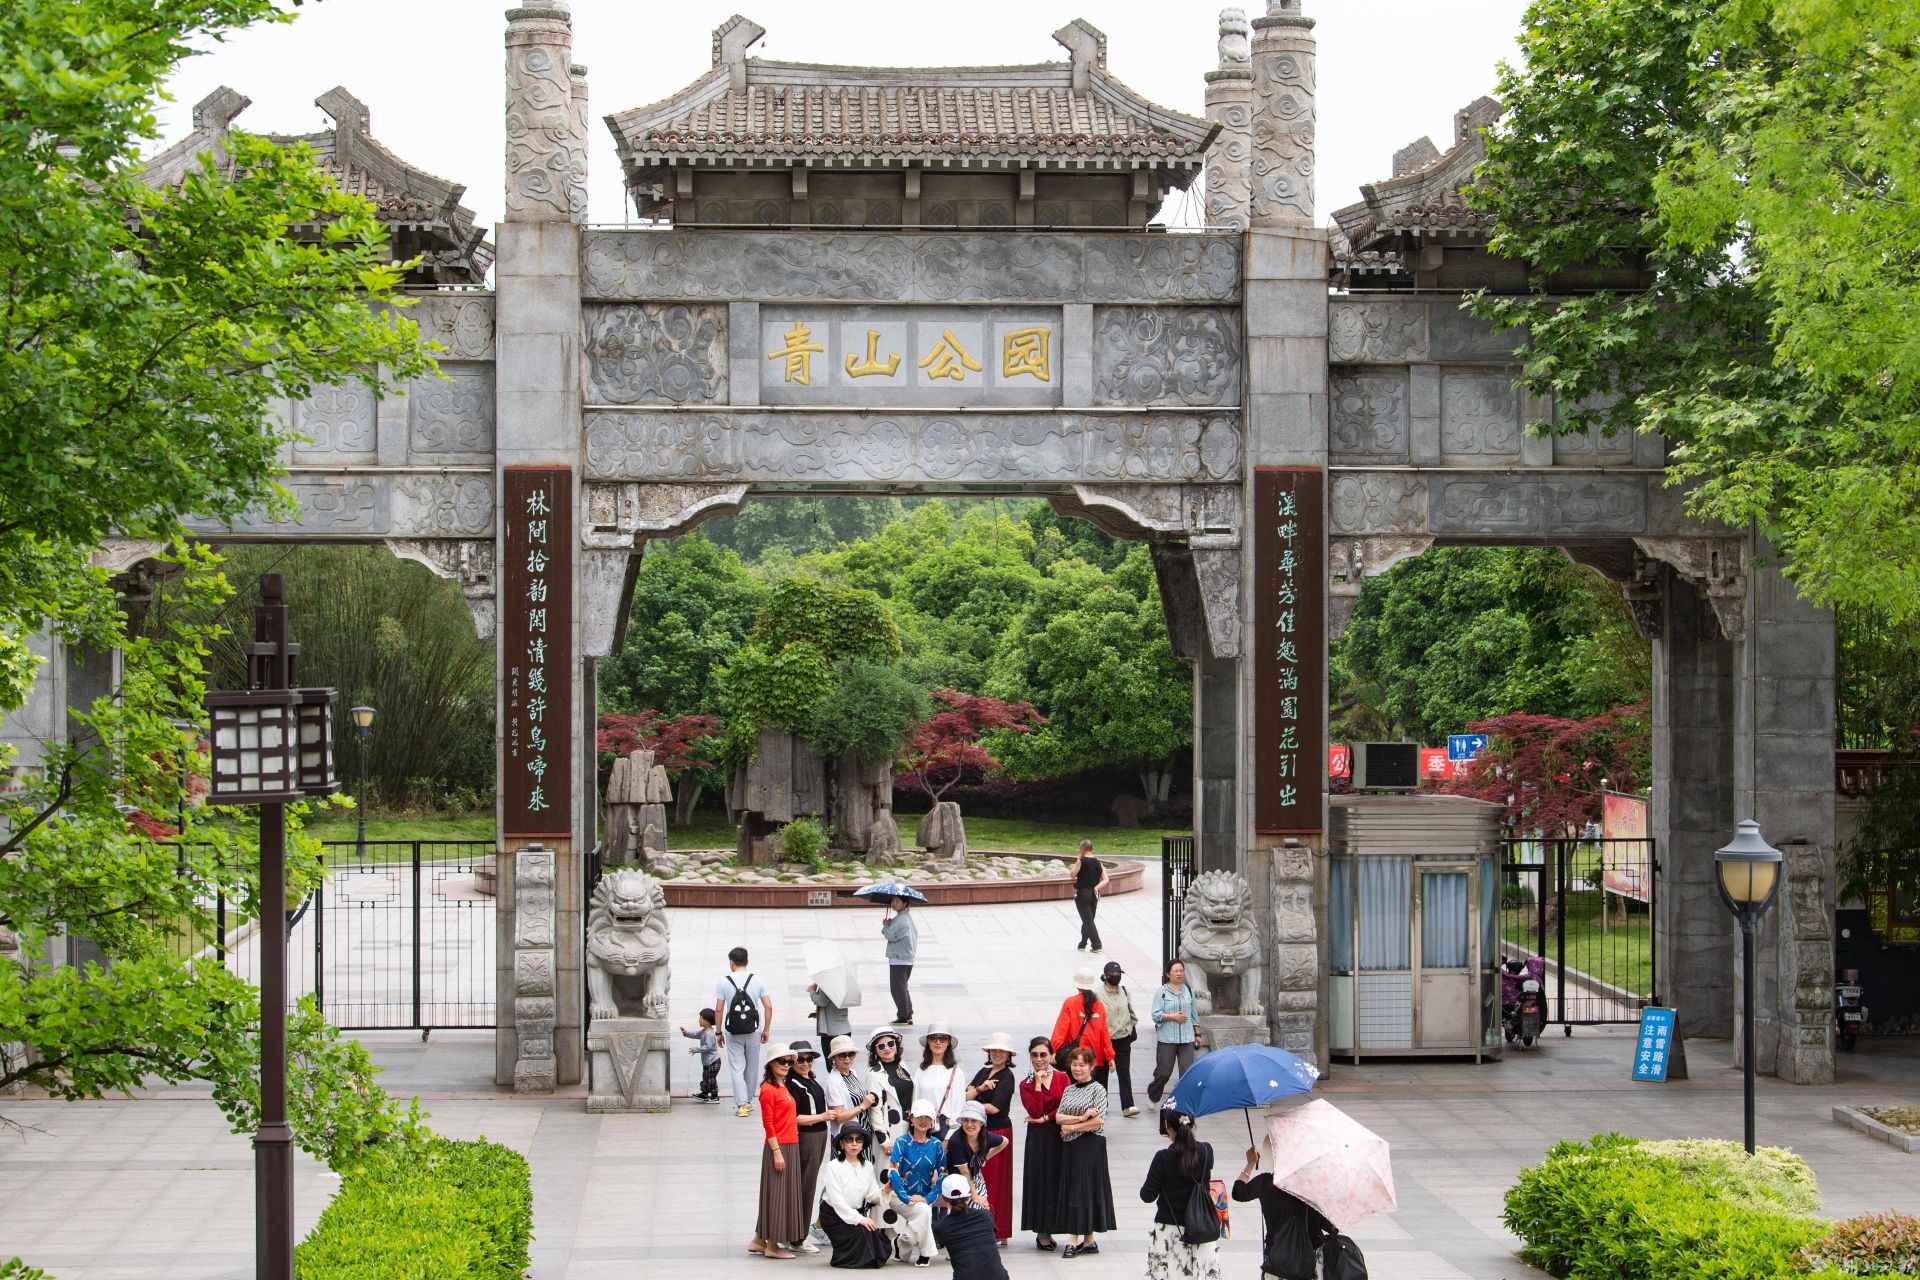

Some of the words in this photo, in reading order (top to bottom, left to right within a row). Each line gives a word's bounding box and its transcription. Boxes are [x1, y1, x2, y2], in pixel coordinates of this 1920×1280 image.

[768, 320, 1051, 386] 青山公园
[1638, 1024, 1654, 1075] 注意安全
[1650, 1025, 1668, 1076] 雨雪路滑
